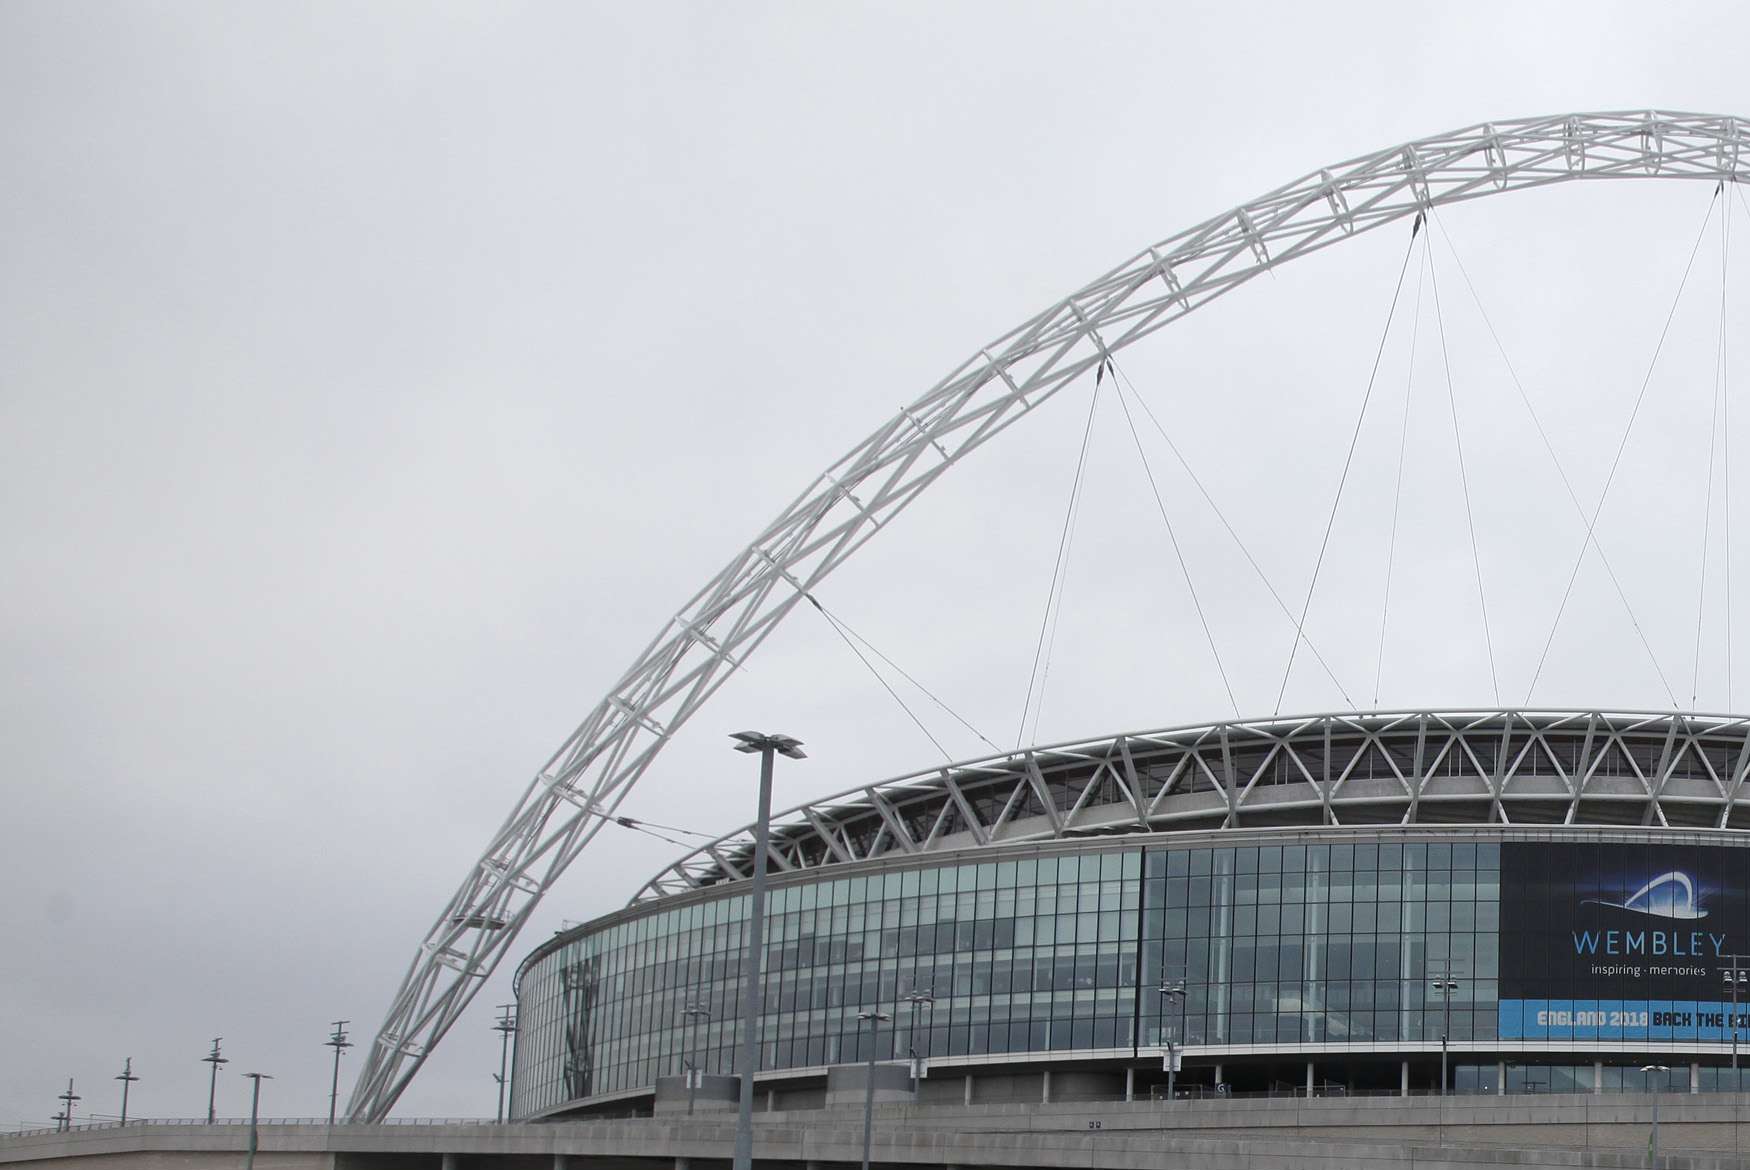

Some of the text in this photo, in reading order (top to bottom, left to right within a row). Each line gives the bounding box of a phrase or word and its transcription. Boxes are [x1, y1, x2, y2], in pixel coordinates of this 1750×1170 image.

[1572, 929, 1726, 957] WEMBLEY
[1591, 963, 1706, 977] inspiring memories
[1537, 1010, 1605, 1026] ENGLAND
[1609, 1011, 1648, 1027] 2018
[1652, 1011, 1692, 1027] BACK
[1695, 1012, 1723, 1028] THE
